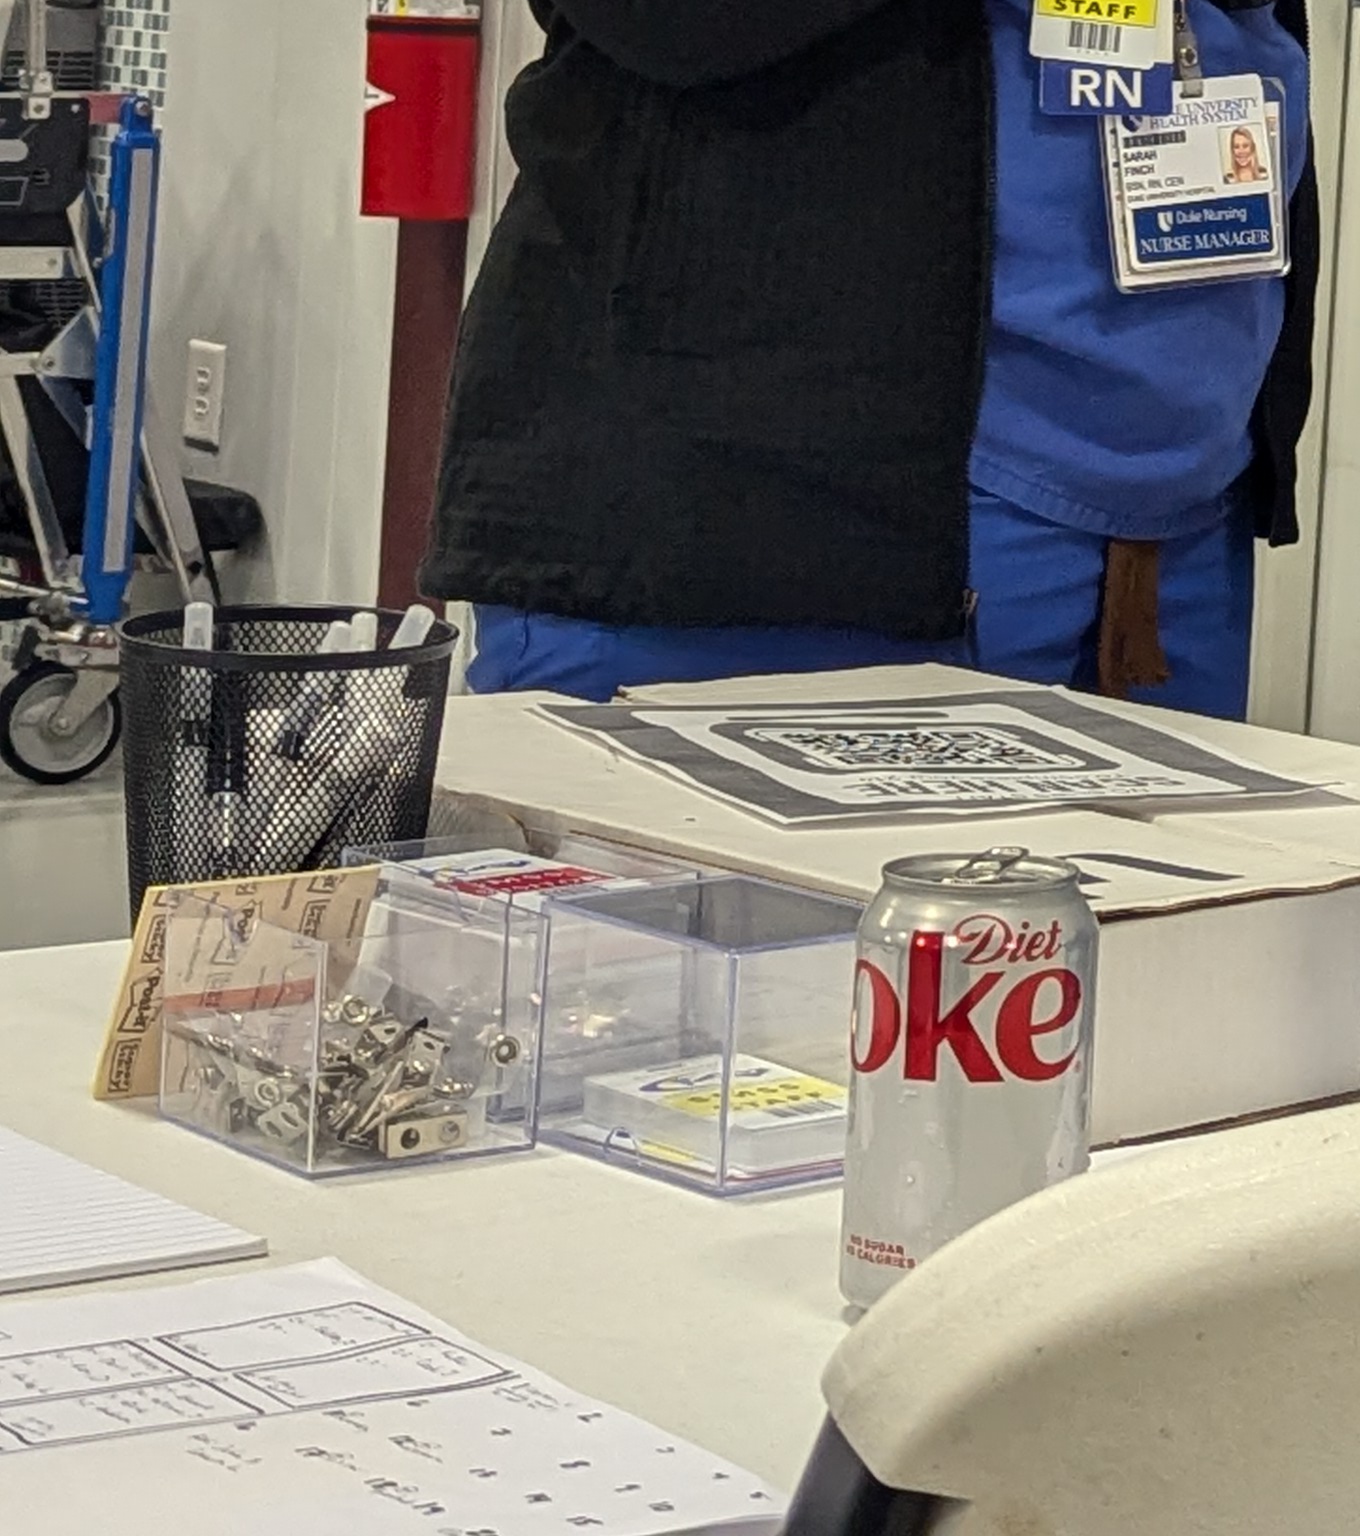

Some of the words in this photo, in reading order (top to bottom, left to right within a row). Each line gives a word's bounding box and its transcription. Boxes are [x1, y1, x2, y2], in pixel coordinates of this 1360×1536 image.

[1069, 68, 1143, 109] RN
[1185, 97, 1259, 115] UNIVERSITY
[1150, 114, 1199, 130] HEALTH
[1201, 109, 1249, 127] SYSTEM
[1122, 149, 1158, 163] SARAH
[1124, 164, 1156, 178] FINCH
[1176, 210, 1203, 225] Duke
[1203, 208, 1248, 223] Nursing
[1140, 235, 1193, 255] NURSE
[1194, 229, 1270, 250] MANAGER
[953, 913, 1063, 965] Diet
